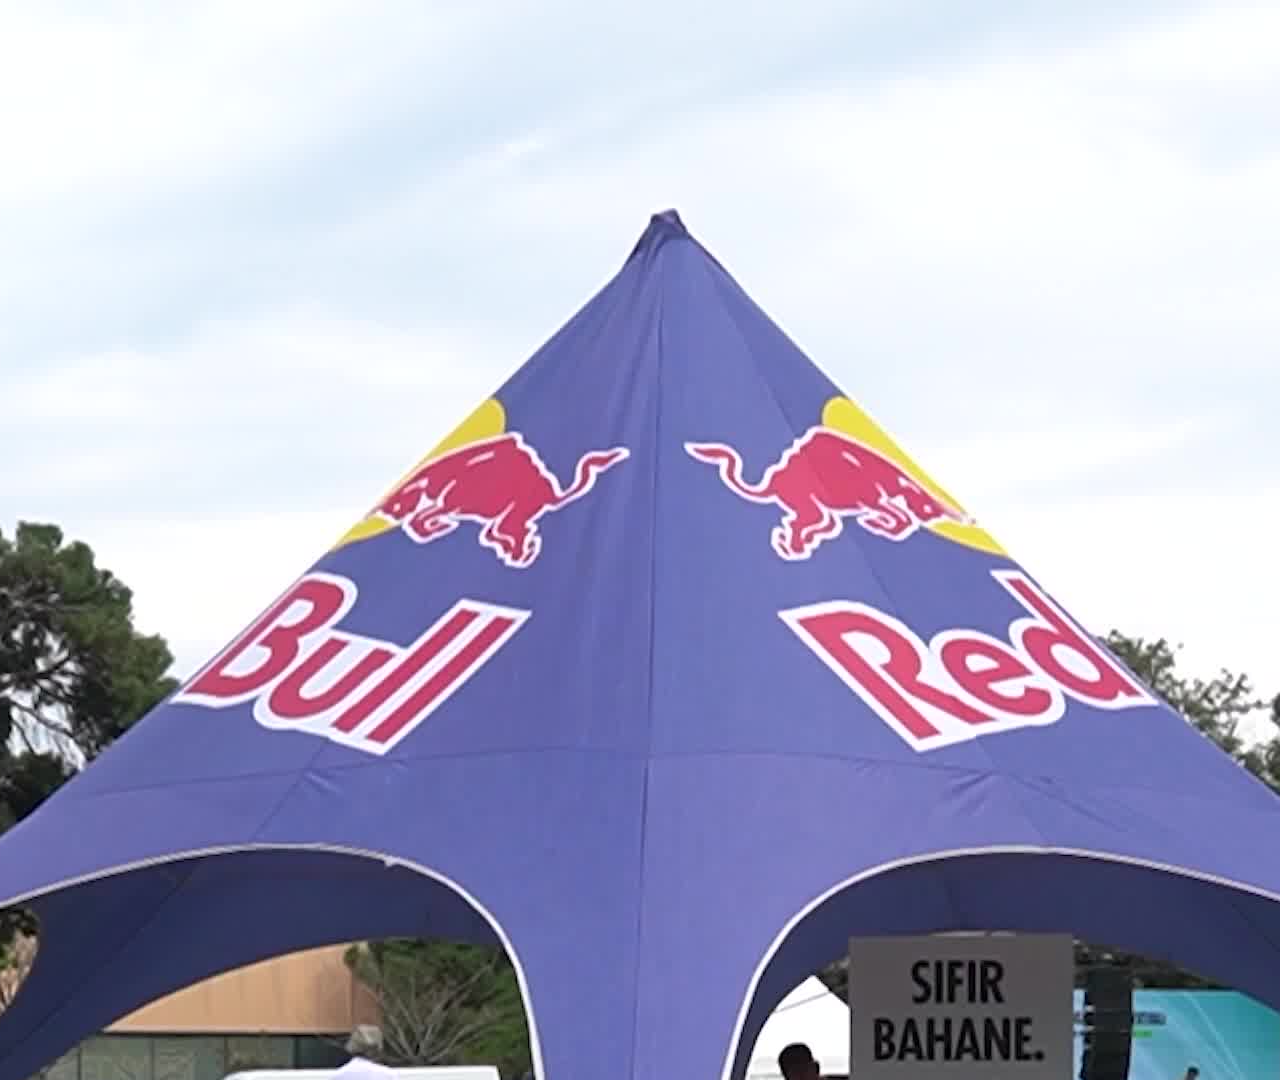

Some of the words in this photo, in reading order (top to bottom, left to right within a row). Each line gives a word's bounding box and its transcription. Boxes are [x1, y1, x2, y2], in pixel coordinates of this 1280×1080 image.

[176, 574, 524, 750] Bull
[786, 573, 1152, 746] Red
[911, 959, 1005, 1004] SIFIR
[872, 1016, 1046, 1062] BAHANE.
